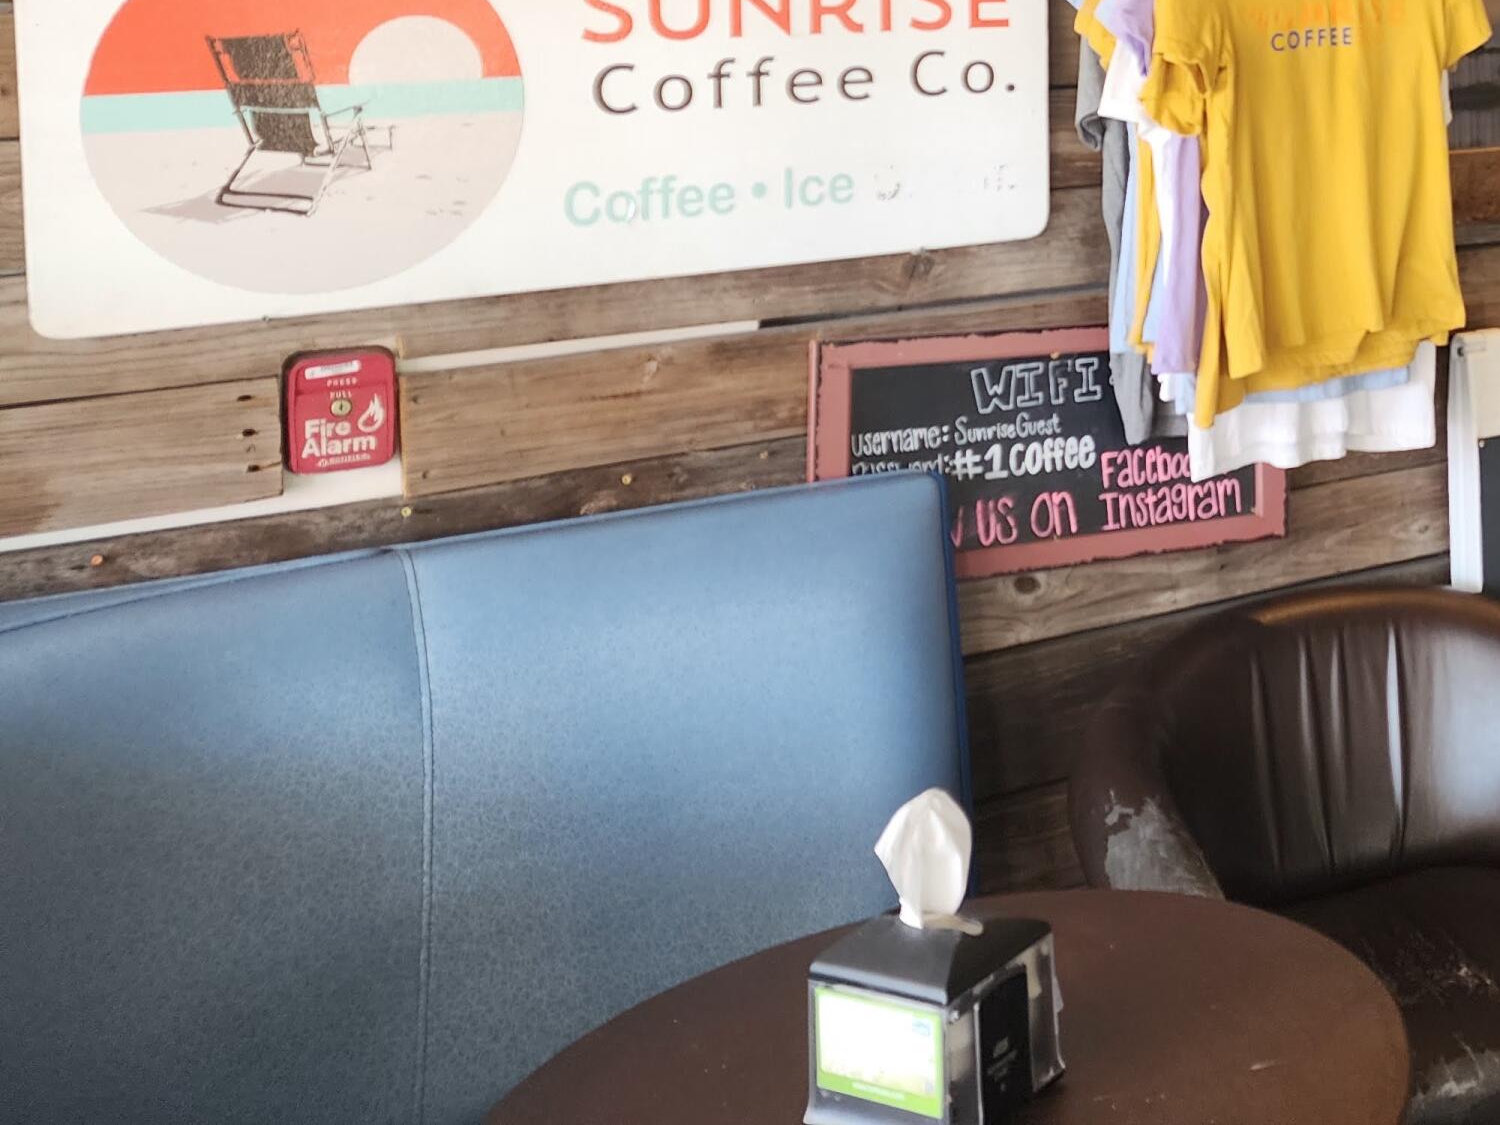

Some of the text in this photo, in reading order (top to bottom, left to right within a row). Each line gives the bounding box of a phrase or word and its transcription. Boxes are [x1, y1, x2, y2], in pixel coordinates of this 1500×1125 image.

[1271, 26, 1353, 52] COFFEE
[591, 49, 1016, 116] Coffee Co.
[563, 174, 737, 227] Coffee
[783, 165, 856, 210] Ice
[301, 434, 377, 459] Alarm
[304, 418, 352, 439] Fire
[1098, 477, 1243, 532] Instagram
